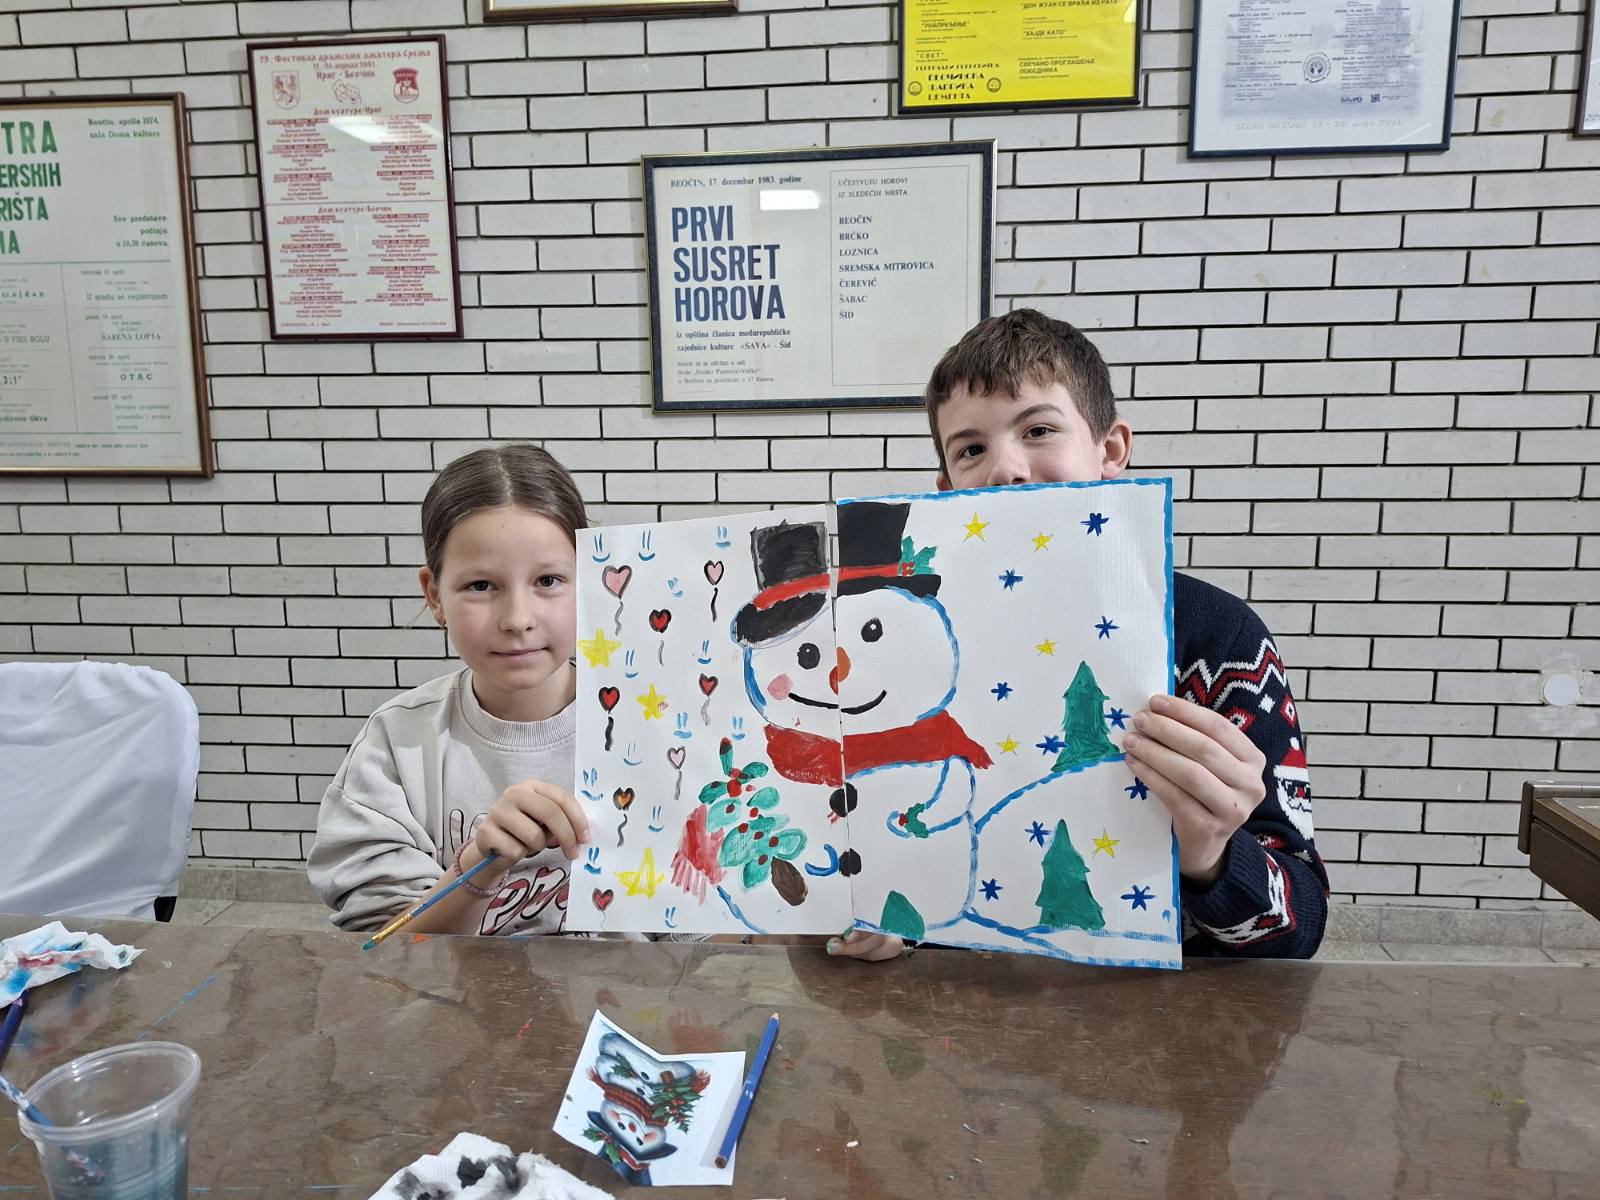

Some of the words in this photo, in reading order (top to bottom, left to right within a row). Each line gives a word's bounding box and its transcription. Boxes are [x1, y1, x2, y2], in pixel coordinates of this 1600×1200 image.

[722, 177, 754, 186] decembar
[758, 176, 775, 185] 1983.
[779, 174, 802, 185] godine
[838, 178, 878, 187] UČESTVUJU
[880, 177, 908, 185] HOROVI
[838, 191, 846, 199] IZ
[885, 189, 908, 197] MESTA
[671, 205, 734, 243] PRVI
[838, 215, 873, 225] BEOČIN
[839, 231, 869, 241] BRČKO
[839, 248, 879, 257] LOZNICA
[673, 244, 780, 283] SUSRET
[839, 263, 881, 273] SREMSKA
[883, 261, 935, 271] MITROVICA
[674, 284, 786, 322] HOROVA
[839, 293, 868, 304] ŠABAC
[838, 310, 854, 319] ŠID
[685, 329, 709, 340] opština
[712, 329, 735, 338] članica
[677, 343, 707, 353] zajednice
[710, 343, 735, 351] kulture
[779, 339, 791, 349] Šid
